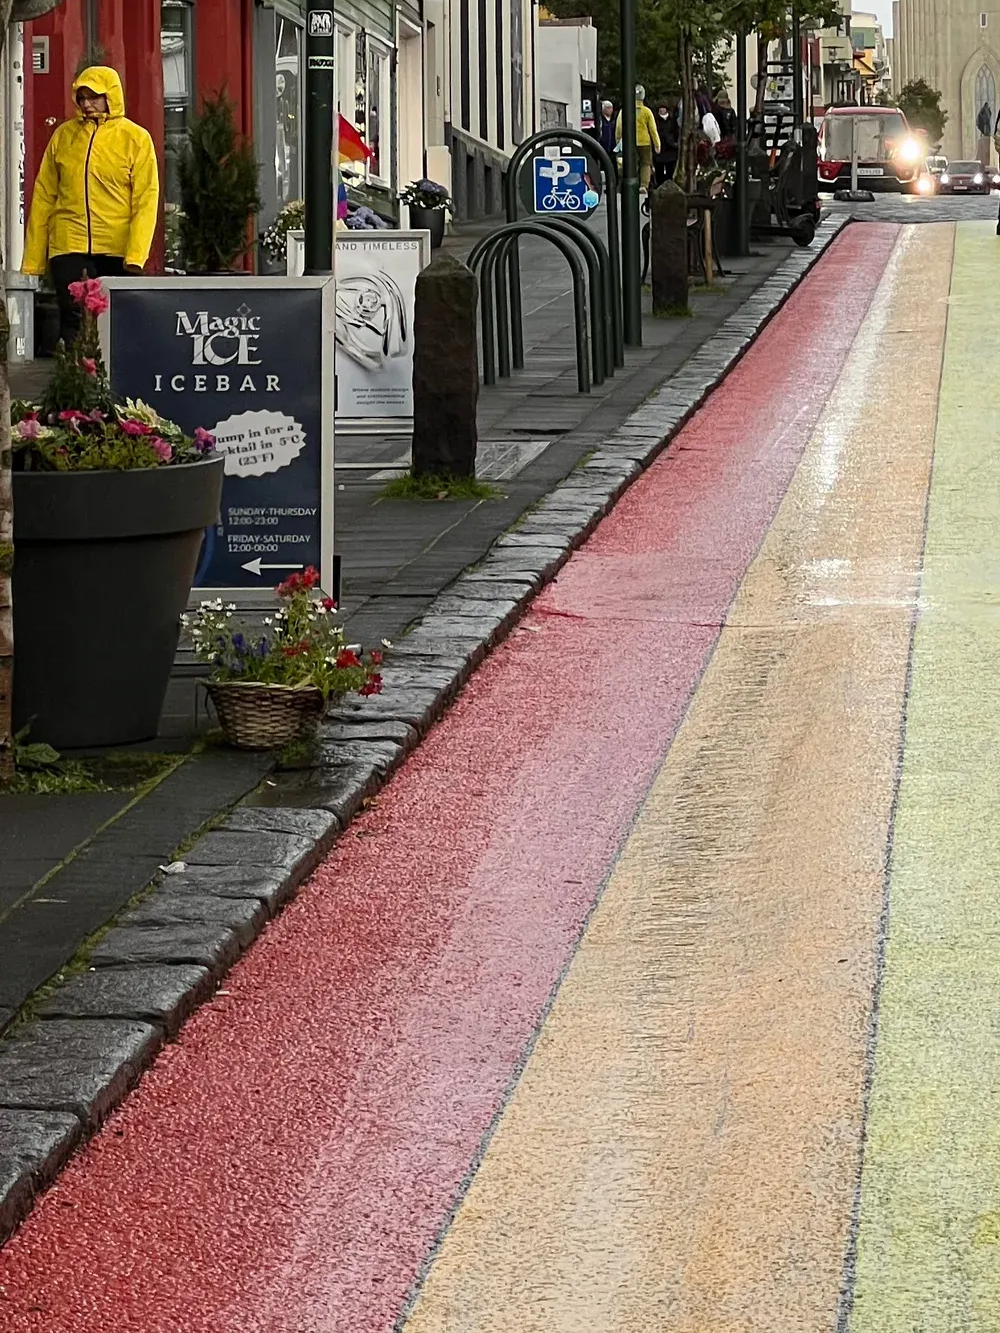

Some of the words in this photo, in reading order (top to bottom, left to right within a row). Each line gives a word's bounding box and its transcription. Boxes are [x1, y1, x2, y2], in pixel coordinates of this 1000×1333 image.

[362, 242, 418, 251] TIMELESS
[175, 310, 261, 338] Magic
[190, 332, 262, 365] ICE
[154, 374, 281, 392] ICEBAR
[217, 432, 245, 444] ump
[248, 429, 261, 439] in
[264, 426, 284, 436] for
[221, 442, 257, 455] cktail
[260, 440, 273, 449] in
[227, 507, 317, 516] SUNDAY-THURSDAY
[228, 516, 279, 525] 12:00-23:00
[227, 534, 311, 543] FRIDAY-SATURDAY
[228, 543, 279, 552] 12:00-00:00
